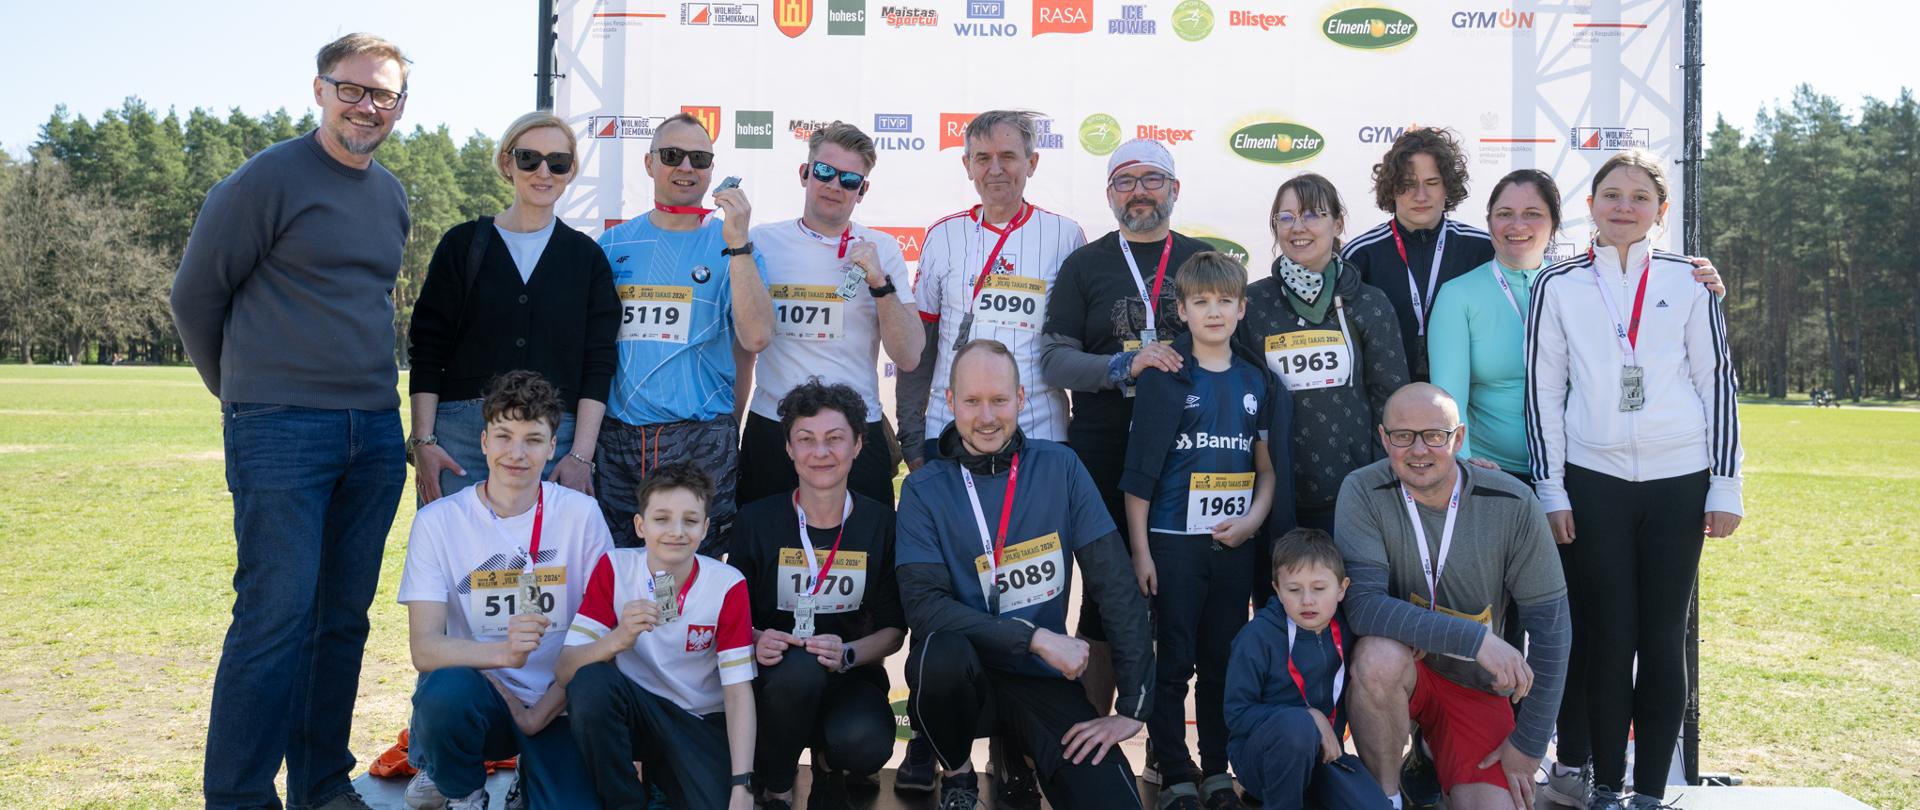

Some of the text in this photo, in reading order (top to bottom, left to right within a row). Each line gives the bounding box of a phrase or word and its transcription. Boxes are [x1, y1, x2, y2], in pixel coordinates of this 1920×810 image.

[714, 5, 742, 14] WOLNOŚĆ
[881, 6, 934, 18] Maistas
[973, 4, 999, 15] TVP
[1040, 8, 1087, 23] RASA
[1121, 5, 1143, 20] ICE
[887, 13, 937, 28] Sportui
[1108, 19, 1156, 35] POWER
[1229, 11, 1286, 31] Blistex
[954, 23, 1017, 37] WILNO
[880, 118, 906, 128] TVP
[1137, 125, 1194, 145] Blistex
[979, 293, 1036, 315] 5090
[623, 306, 680, 325] 5119
[778, 305, 830, 325] 1071
[1278, 351, 1339, 374] 1963
[1200, 496, 1246, 516] 1963
[995, 560, 1056, 594] 5089
[485, 592, 554, 616] 510
